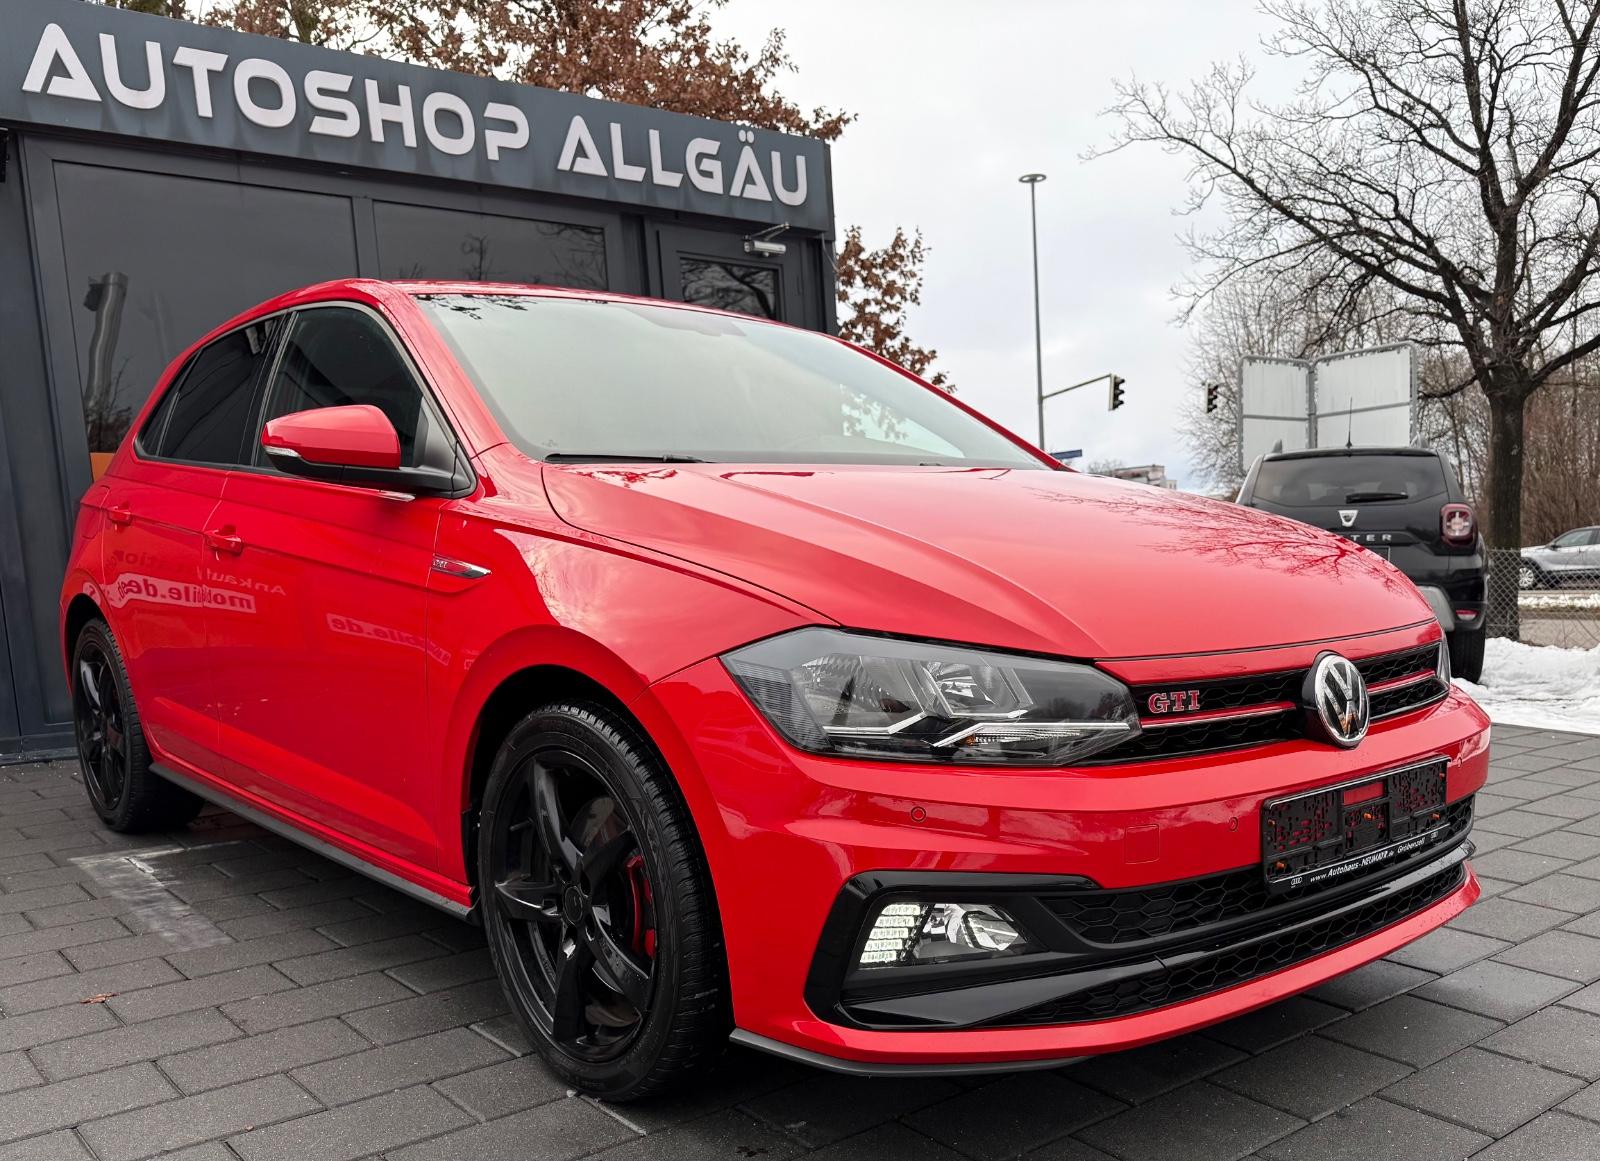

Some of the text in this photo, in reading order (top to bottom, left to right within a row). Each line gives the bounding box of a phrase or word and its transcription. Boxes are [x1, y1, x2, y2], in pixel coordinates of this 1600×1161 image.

[22, 22, 807, 206] AUTOSHOP ALLGÄU
[1148, 689, 1200, 714] GTI
